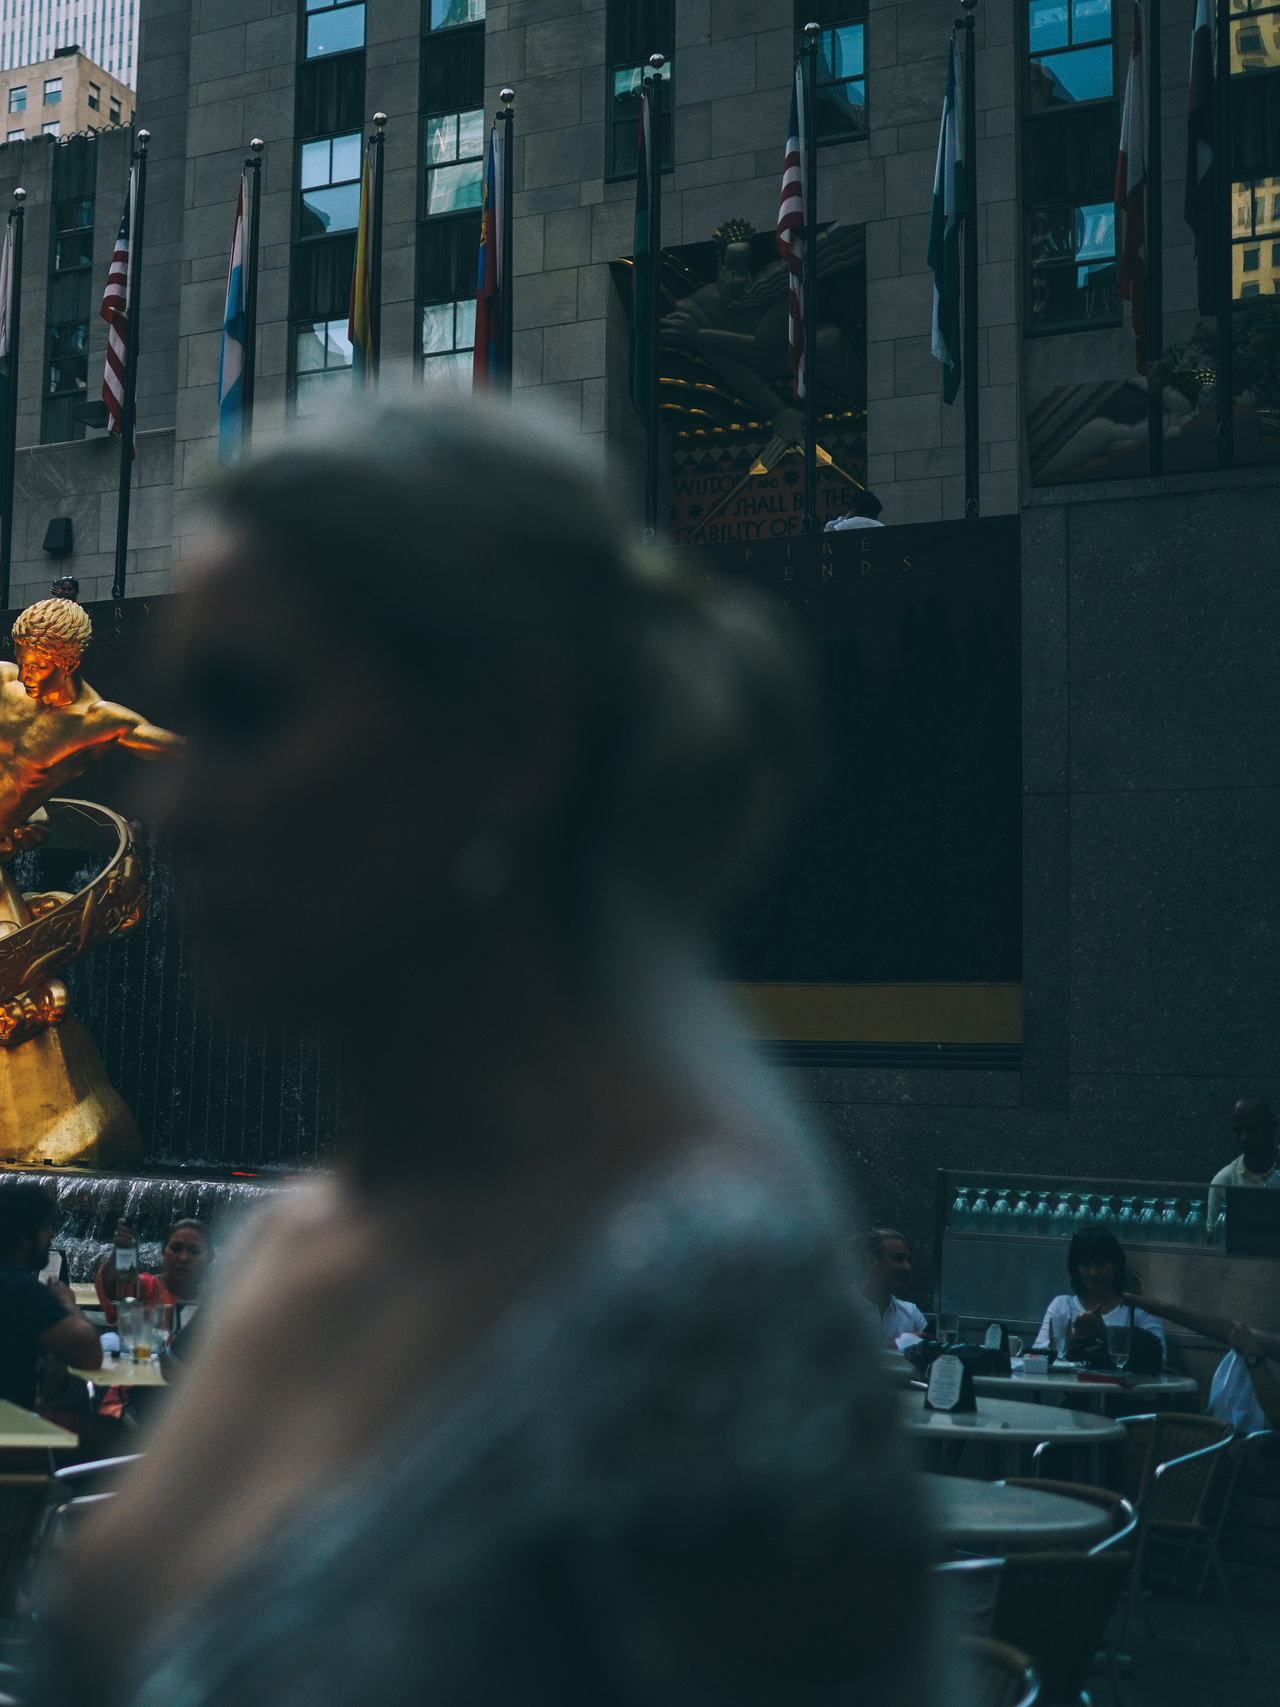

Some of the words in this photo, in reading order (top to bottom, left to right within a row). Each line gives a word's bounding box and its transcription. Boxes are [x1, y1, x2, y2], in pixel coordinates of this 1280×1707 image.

[756, 477, 778, 490] AND
[733, 494, 788, 516] SHALL
[821, 487, 851, 507] THE
[676, 519, 766, 544] STABILITY
[769, 517, 798, 537] OF
[745, 536, 871, 563] FIRE
[783, 556, 912, 581] ENDS
